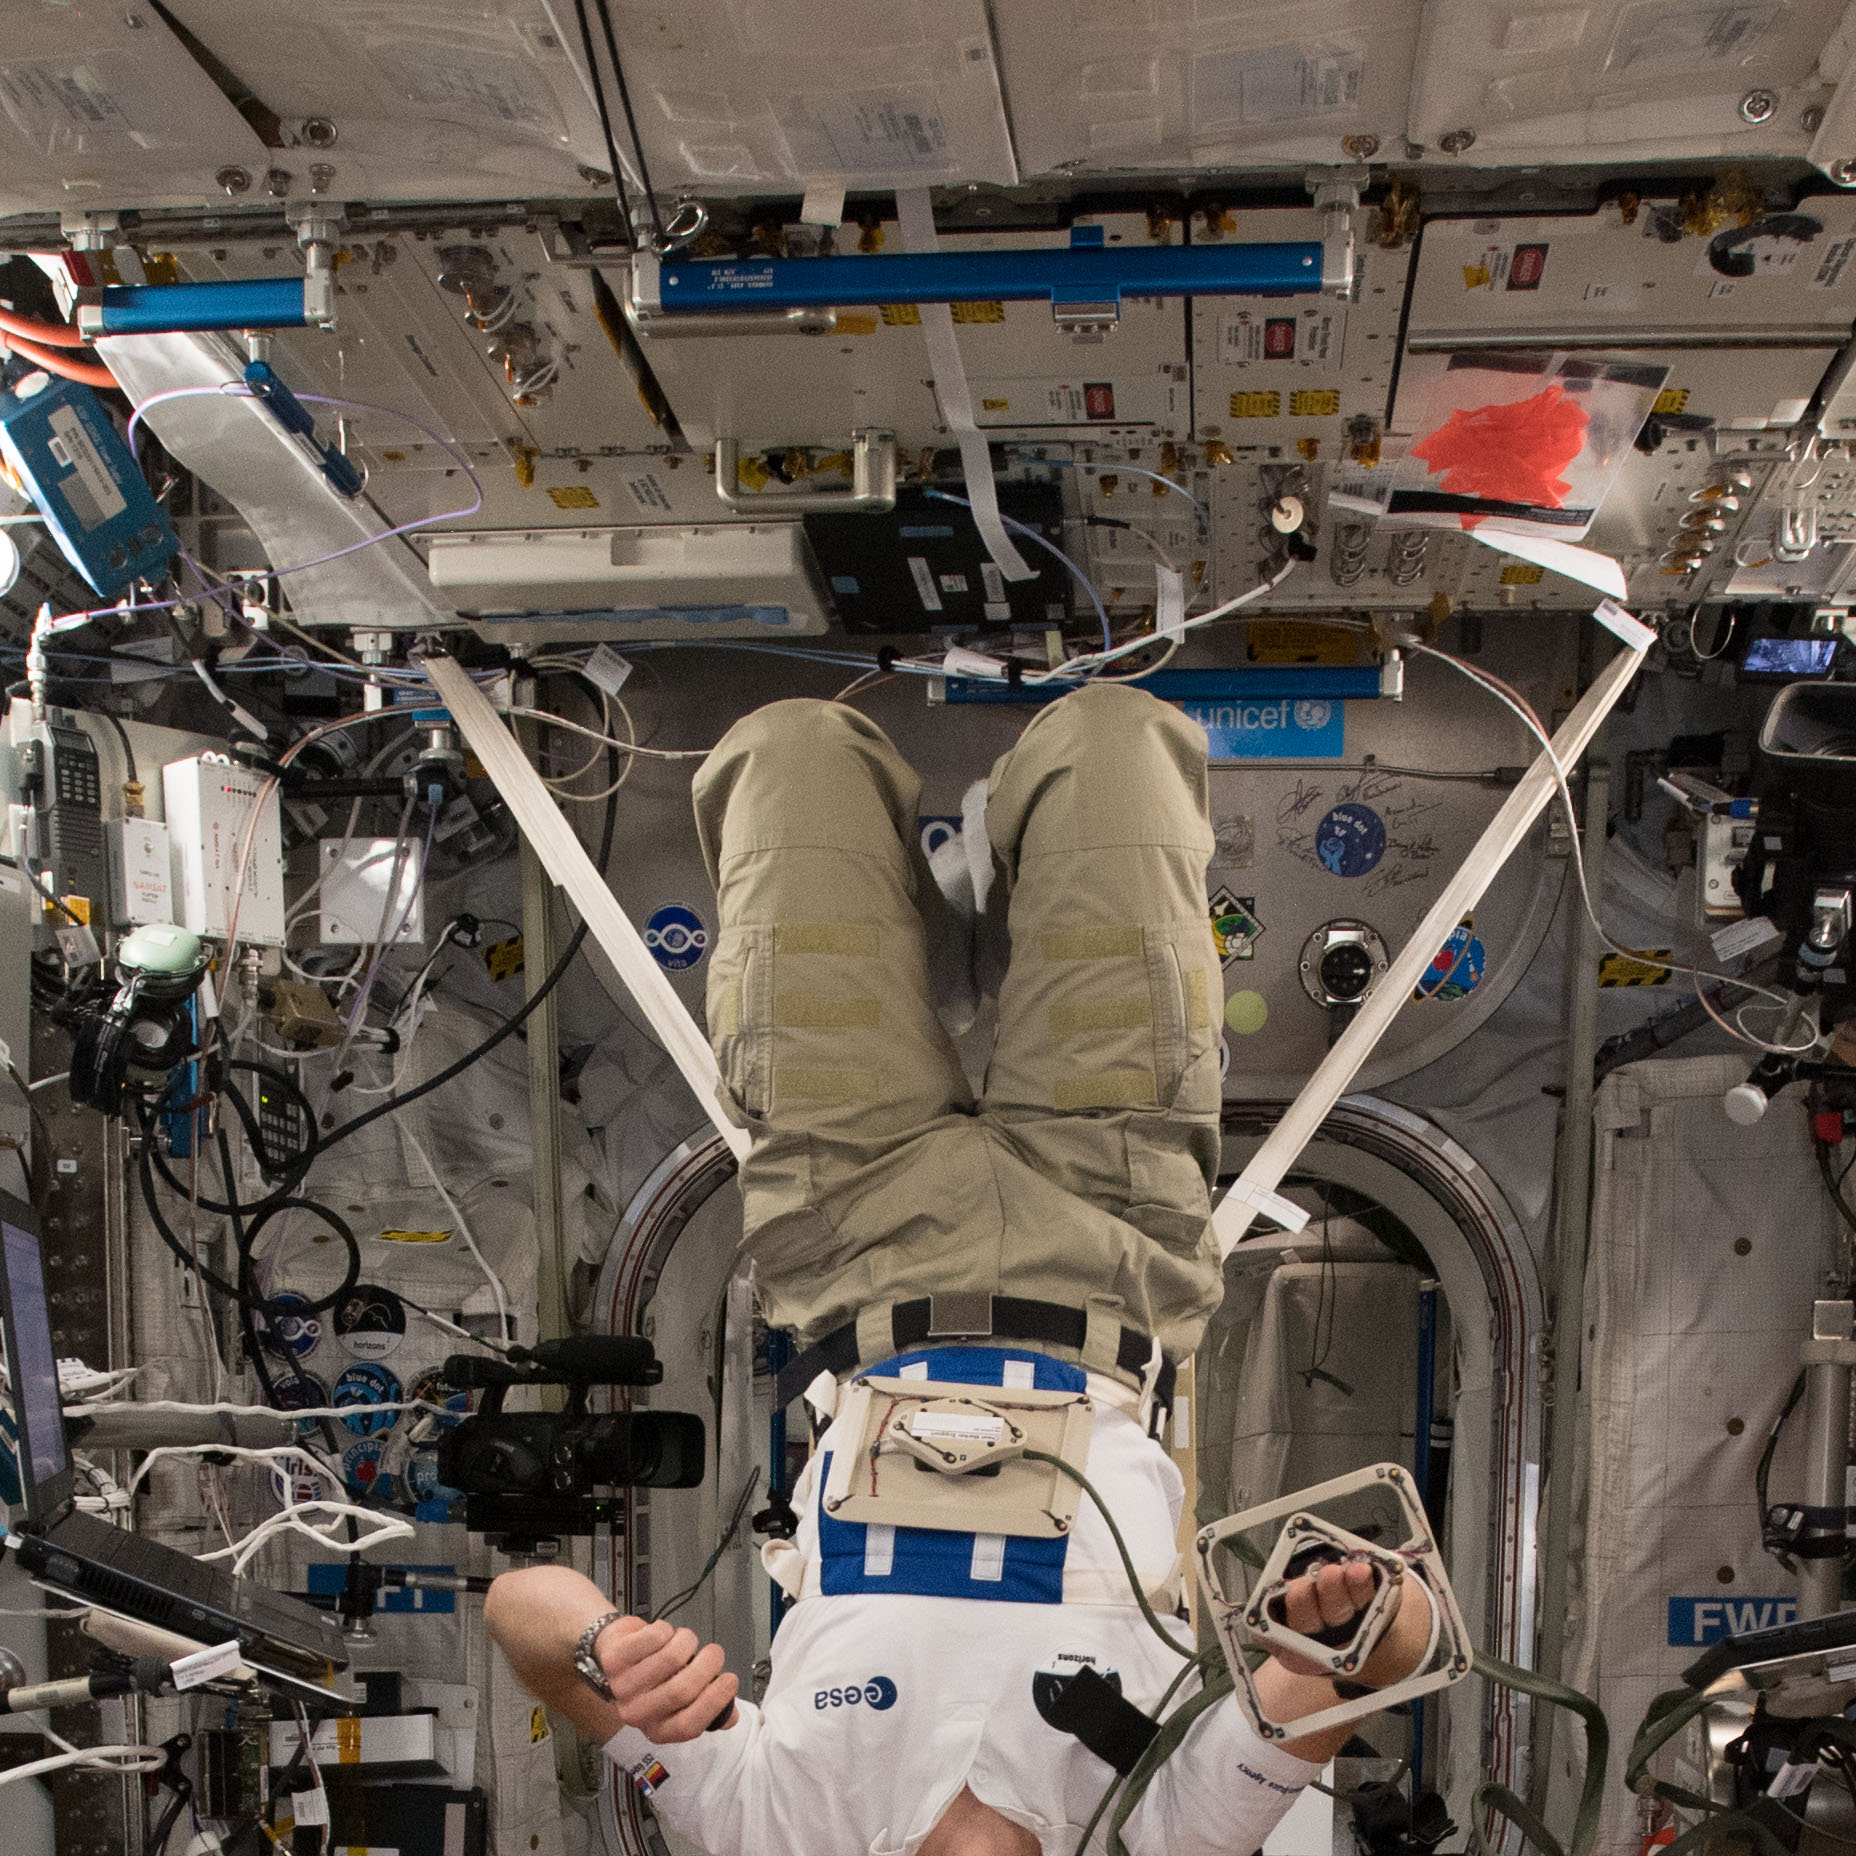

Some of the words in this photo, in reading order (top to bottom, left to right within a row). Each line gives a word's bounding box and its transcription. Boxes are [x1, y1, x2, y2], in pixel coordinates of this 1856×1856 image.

[1194, 704, 1290, 729] unicef
[1332, 811, 1353, 825] blue
[1353, 818, 1369, 836] dot
[353, 1340, 385, 1350] horizons
[346, 1373, 367, 1383] blue
[369, 1379, 385, 1392] dot
[1057, 1652, 1096, 1665] horizons
[1237, 1763, 1266, 1784] Agency
